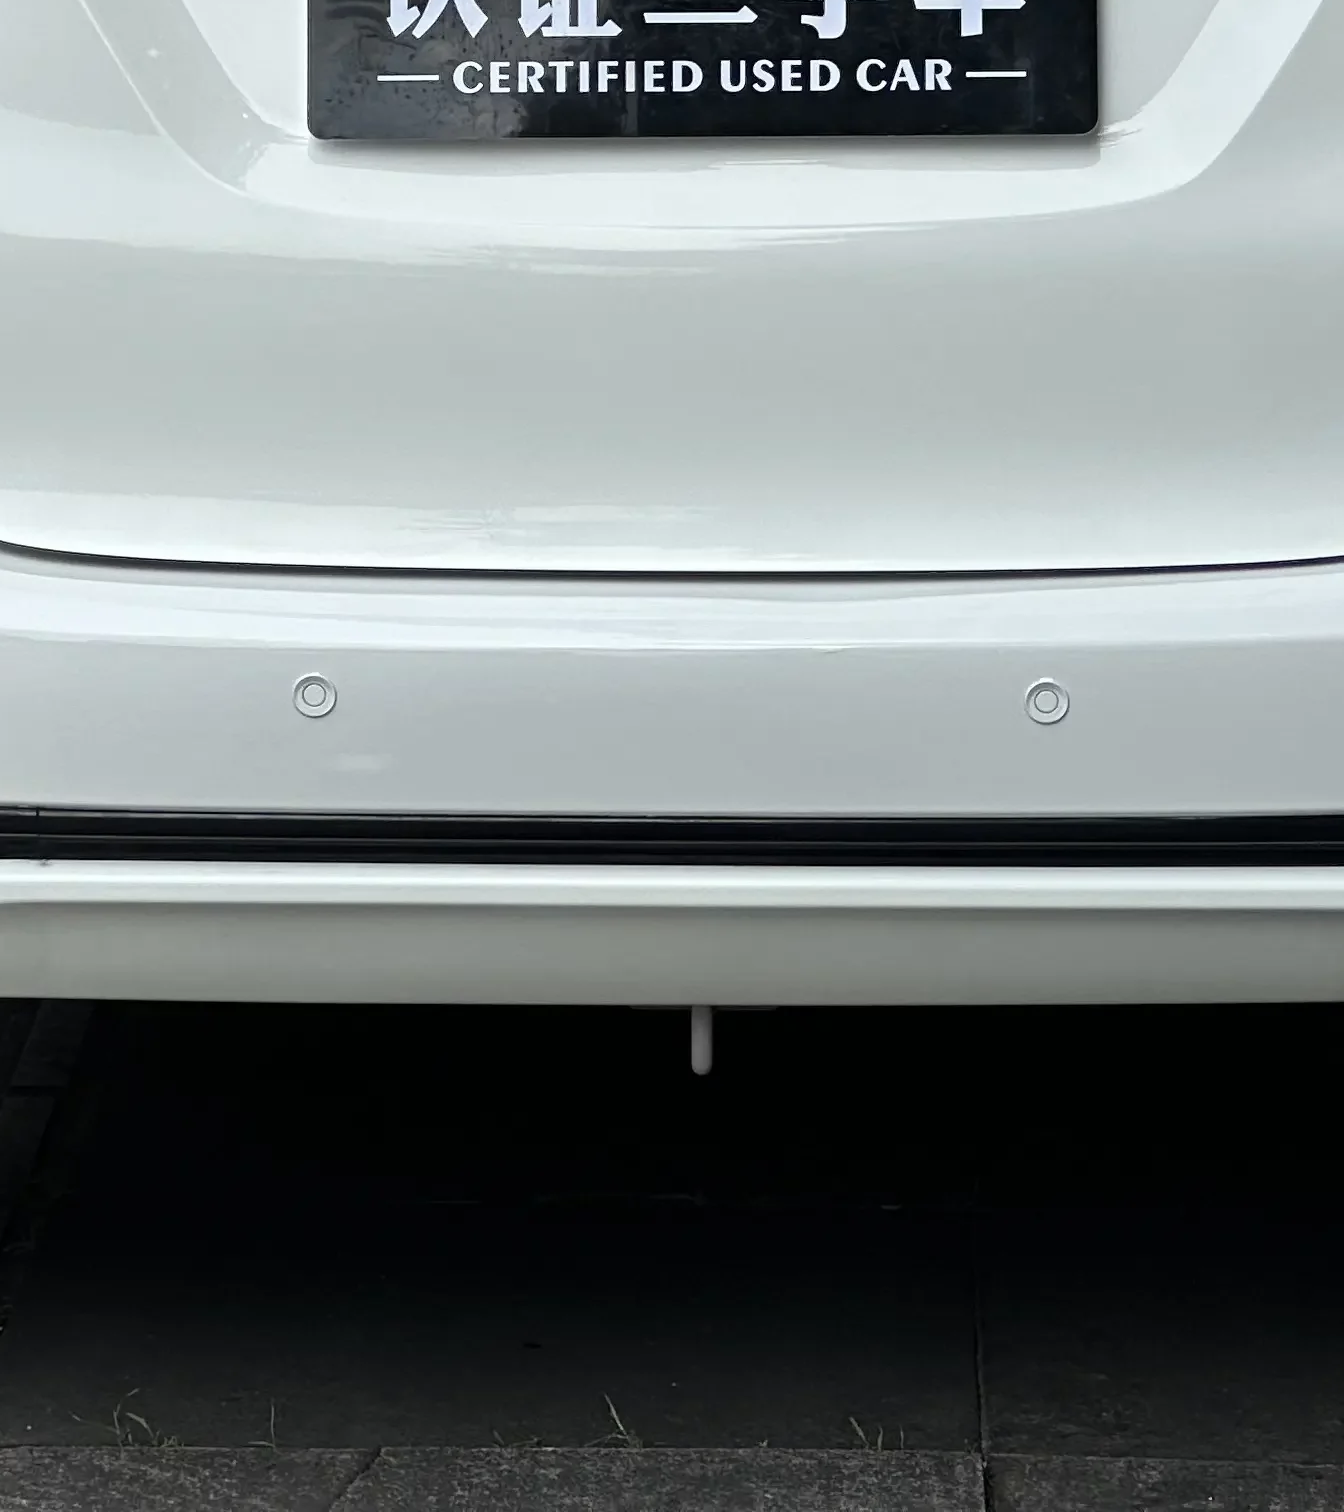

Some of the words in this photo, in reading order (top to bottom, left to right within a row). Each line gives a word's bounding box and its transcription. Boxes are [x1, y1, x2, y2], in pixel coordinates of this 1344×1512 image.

[452, 59, 704, 94] CERTIFIED
[720, 58, 841, 92] USED
[856, 57, 953, 92] CAR
